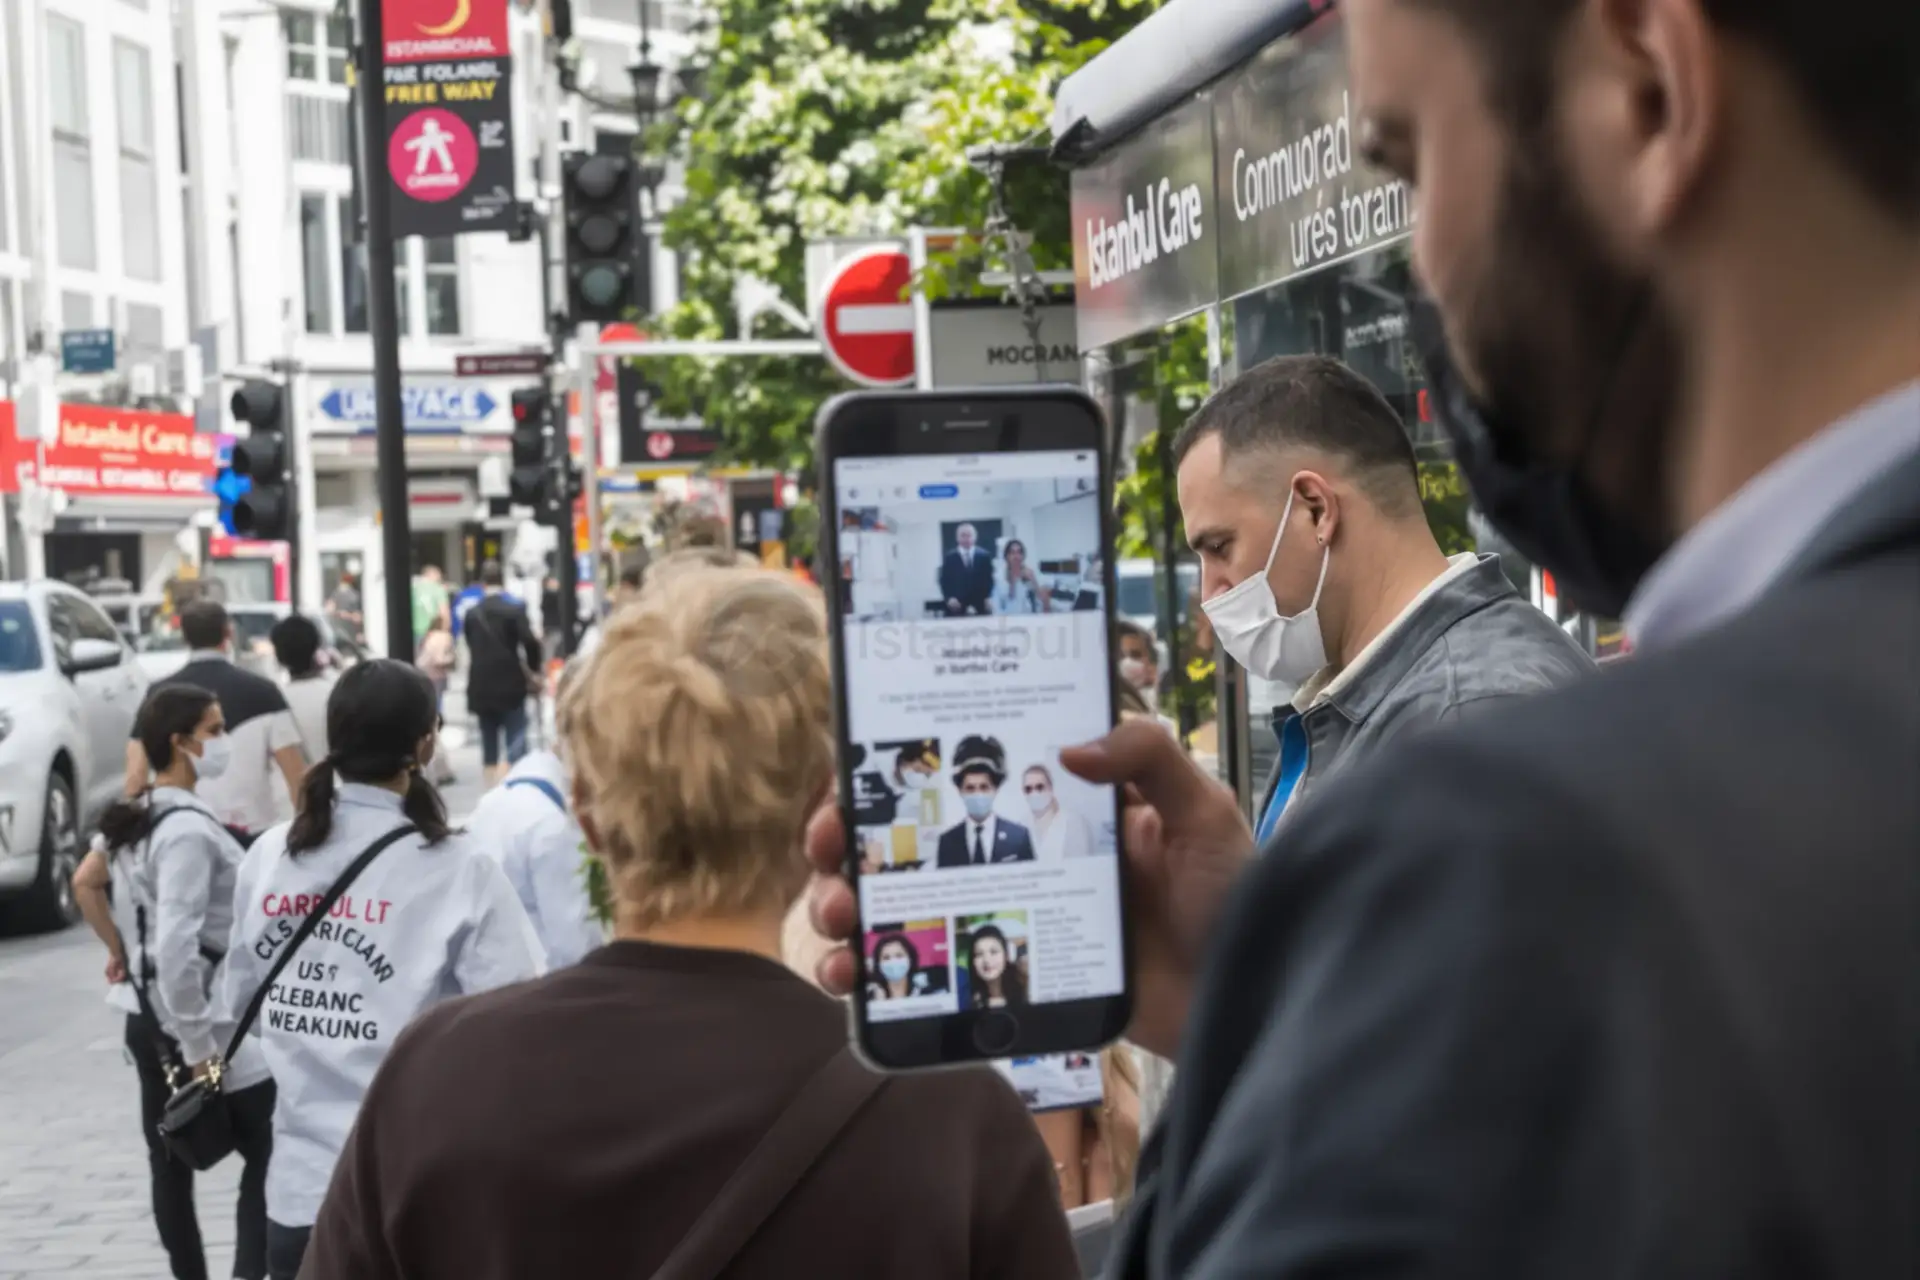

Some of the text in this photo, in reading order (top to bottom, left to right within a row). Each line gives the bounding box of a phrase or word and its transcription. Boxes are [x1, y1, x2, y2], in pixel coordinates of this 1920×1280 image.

[384, 80, 496, 106] FREE WAY
[1233, 90, 1351, 221] Conmuorad
[1087, 177, 1203, 290] Istanbul Care
[365, 899, 393, 924] LT
[269, 984, 364, 1013] CLEBANC
[269, 1009, 378, 1041] WEAKUNG
